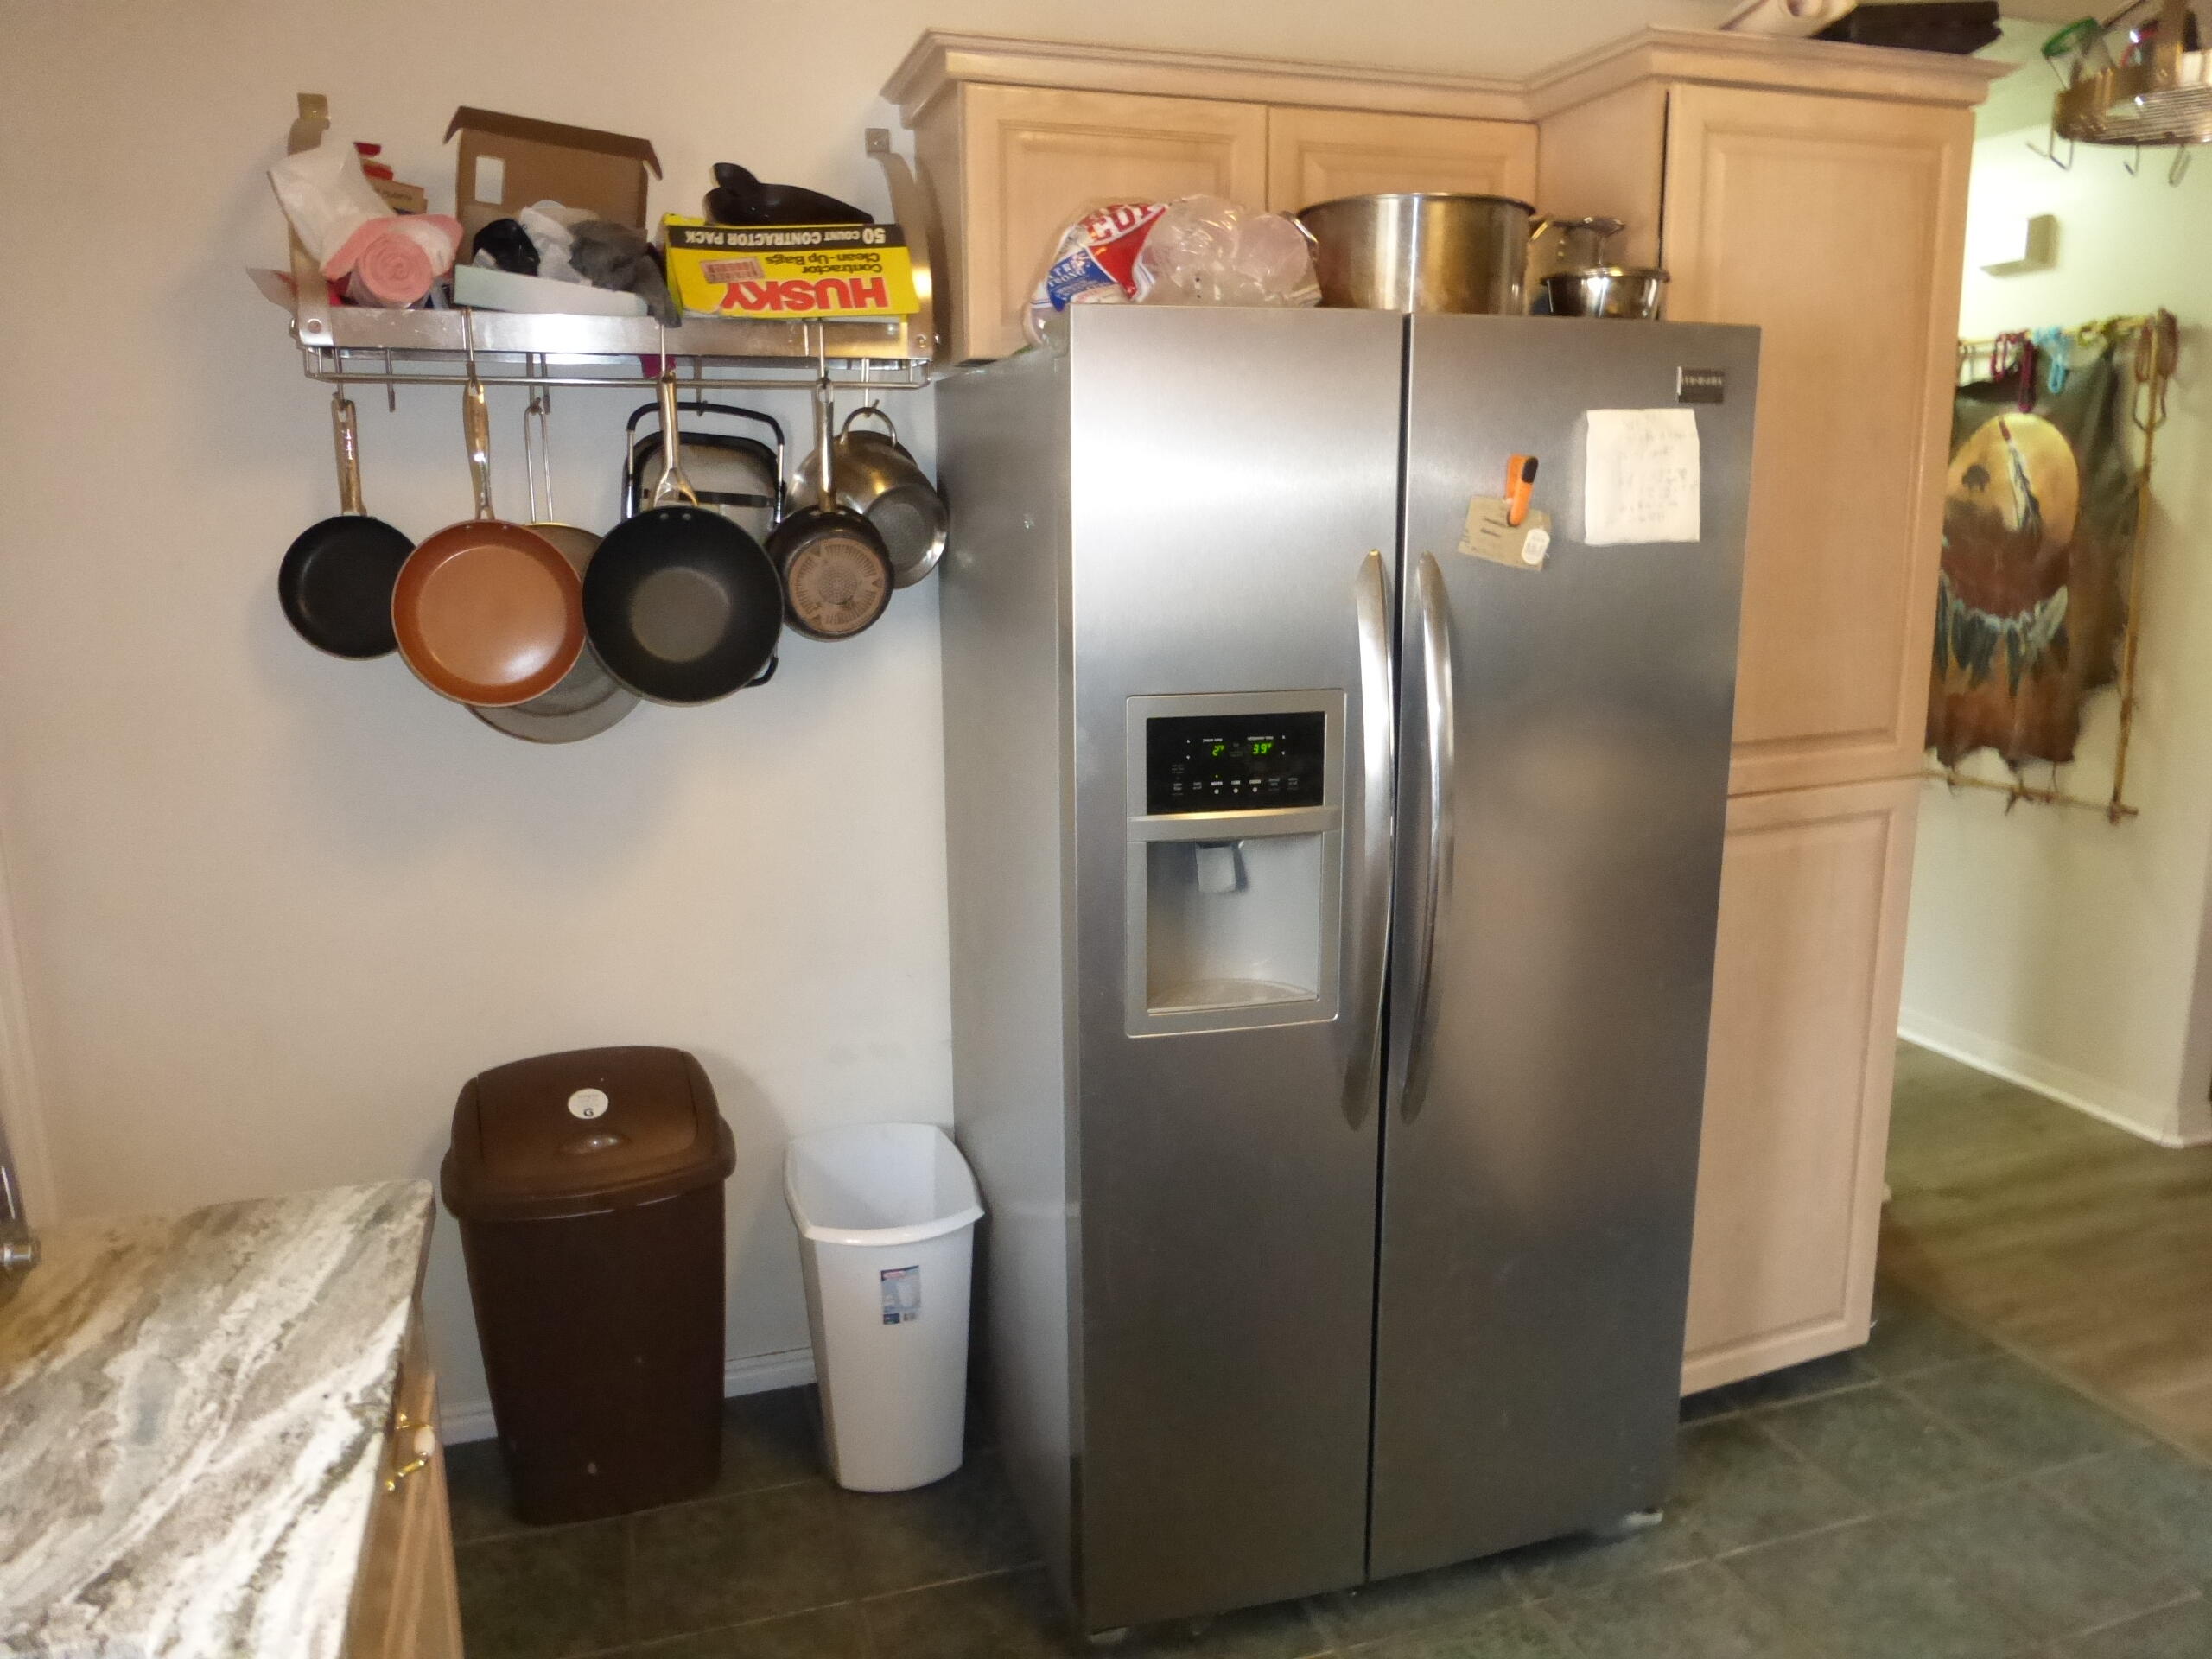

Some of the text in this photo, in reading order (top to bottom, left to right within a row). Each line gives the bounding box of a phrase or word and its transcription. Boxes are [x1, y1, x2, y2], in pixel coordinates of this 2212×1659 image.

[684, 227, 887, 246] 50 COUNT CONTRACTOR PACK
[765, 253, 804, 265] Bags
[802, 264, 883, 275] Contractor
[722, 277, 888, 310] HUSKY
